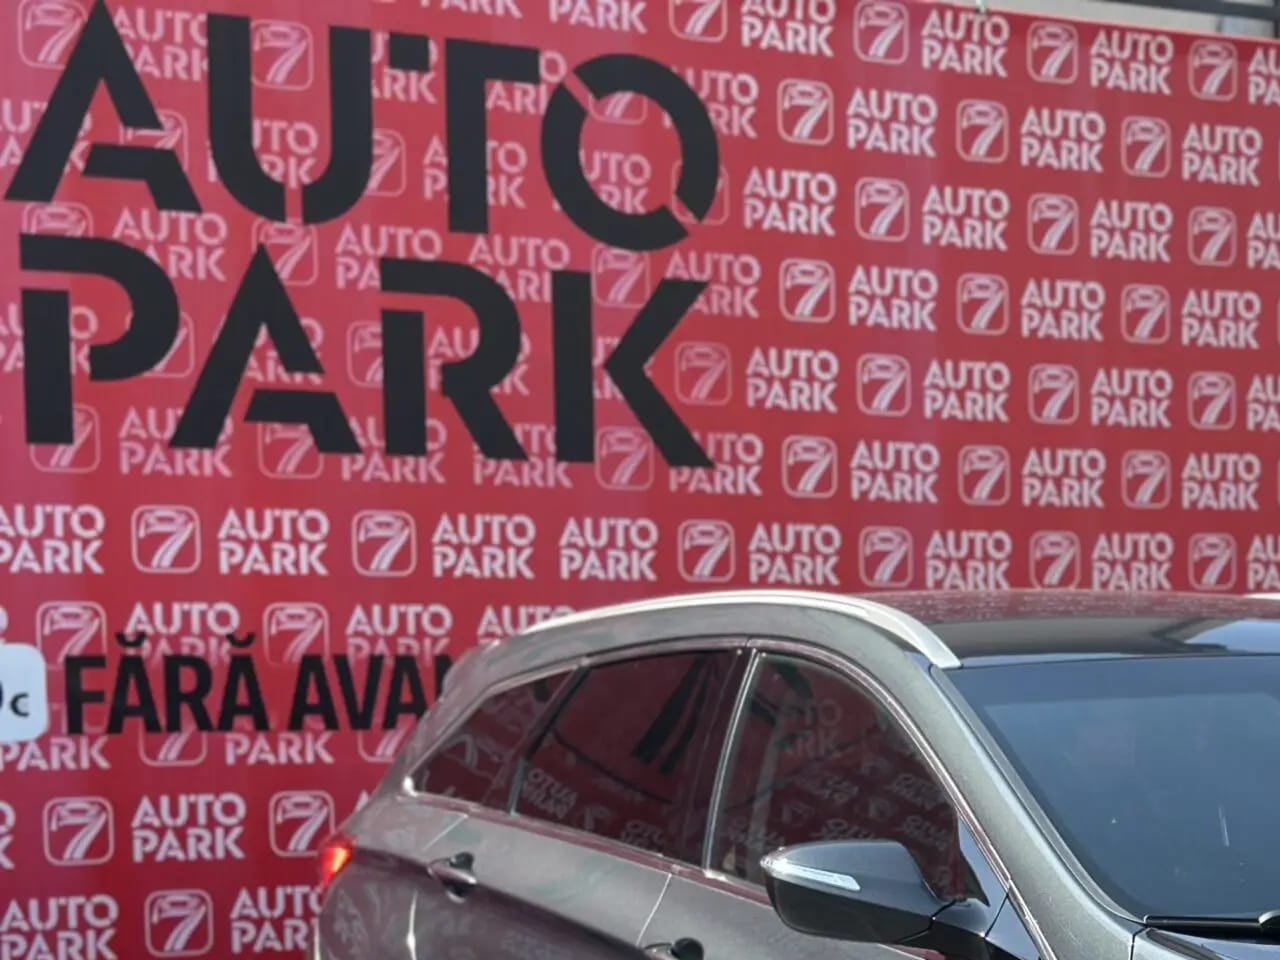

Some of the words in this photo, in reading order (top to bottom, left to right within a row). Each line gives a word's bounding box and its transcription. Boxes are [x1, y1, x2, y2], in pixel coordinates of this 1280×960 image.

[742, 17, 833, 57] PARK
[922, 9, 1009, 45] AUTO
[922, 41, 1007, 77] PARK
[1090, 31, 1174, 63] AUTO
[1090, 59, 1171, 95] PARK
[847, 88, 937, 126] AUTO
[1021, 107, 1106, 141] AUTO
[3, 0, 720, 252] AUTO
[847, 120, 936, 157] PARK
[1182, 124, 1262, 156] AUTO
[1021, 136, 1104, 173] PARK
[1182, 152, 1260, 187] PARK
[744, 167, 837, 203] AUTO
[744, 199, 835, 236] PARK
[922, 185, 1010, 220] AUTO
[1090, 199, 1173, 232] AUTO
[113, 207, 228, 246] AUTO
[336, 224, 442, 262] AUTO
[923, 215, 1008, 251] PARK
[469, 234, 571, 270] AUTO
[1090, 229, 1170, 263] PARK
[849, 265, 938, 302] AUTO
[1022, 278, 1106, 312] AUTO
[849, 297, 936, 331] PARK
[1183, 289, 1261, 320] AUTO
[1021, 308, 1103, 341] PARK
[1182, 318, 1259, 349] PARK
[19, 233, 716, 469] PARK
[746, 347, 839, 381] AUTO
[924, 359, 1011, 391] AUTO
[1091, 368, 1173, 398] AUTO
[746, 378, 837, 414] PARK
[924, 389, 1008, 423] PARK
[1091, 396, 1171, 428] PARK
[120, 441, 233, 478] PARK
[850, 440, 940, 472] AUTO
[1021, 448, 1106, 478] AUTO
[1182, 453, 1261, 483] AUTO
[851, 470, 937, 503] PARK
[1022, 477, 1104, 508] PARK
[1182, 481, 1259, 511] PARK
[218, 508, 330, 541] AUTO
[431, 513, 536, 547] AUTO
[560, 517, 658, 550] AUTO
[748, 522, 842, 553] AUTO
[218, 541, 329, 575] PARK
[926, 530, 1012, 560] AUTO
[1092, 532, 1174, 563] AUTO
[432, 546, 535, 580] PARK
[560, 549, 657, 581] PARK
[749, 553, 840, 586] PARK
[926, 558, 1009, 590] PARK
[1092, 560, 1171, 591] PARK
[124, 602, 240, 635] AUTO
[345, 605, 451, 635] AUTO
[64, 632, 270, 735] FĂRĂ
[225, 731, 334, 766] PARK
[131, 793, 246, 828] AUTO
[132, 826, 245, 862] PARK
[1, 894, 119, 932] AUTO
[231, 919, 319, 953] PAR
